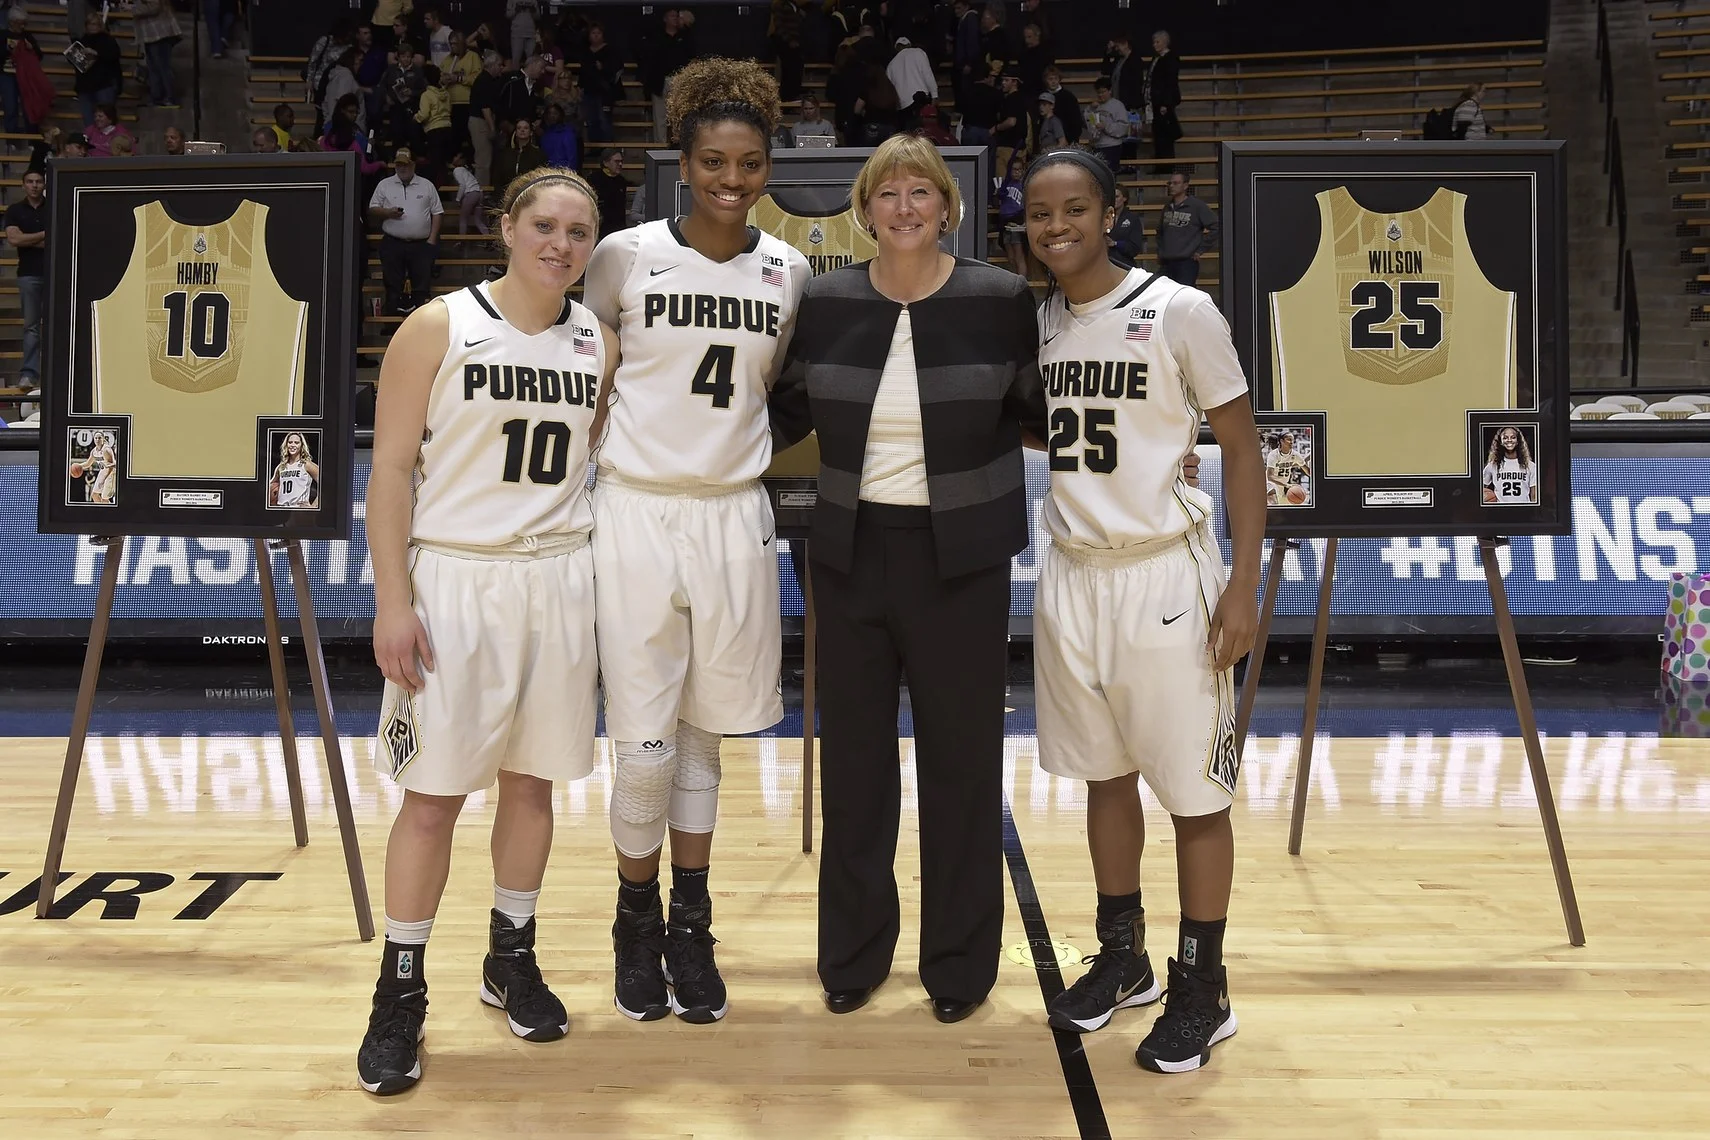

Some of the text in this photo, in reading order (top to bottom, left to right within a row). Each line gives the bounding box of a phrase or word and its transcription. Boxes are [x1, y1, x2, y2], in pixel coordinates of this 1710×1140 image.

[177, 262, 218, 285] HAMBY
[804, 254, 852, 277] RNTON
[1368, 250, 1423, 274] WILSON
[163, 291, 230, 359] 10
[645, 293, 780, 337] PURDUE
[1350, 280, 1443, 350] 25
[464, 363, 598, 410] PURDUE
[690, 343, 737, 410] 4
[1042, 360, 1148, 400] PURDUE
[501, 418, 571, 486] 10
[1050, 407, 1118, 474] 25
[282, 480, 293, 494] 10
[1497, 472, 1527, 481] PURDUE
[1502, 481, 1522, 497] 25
[203, 636, 289, 644] DAKTRONS
